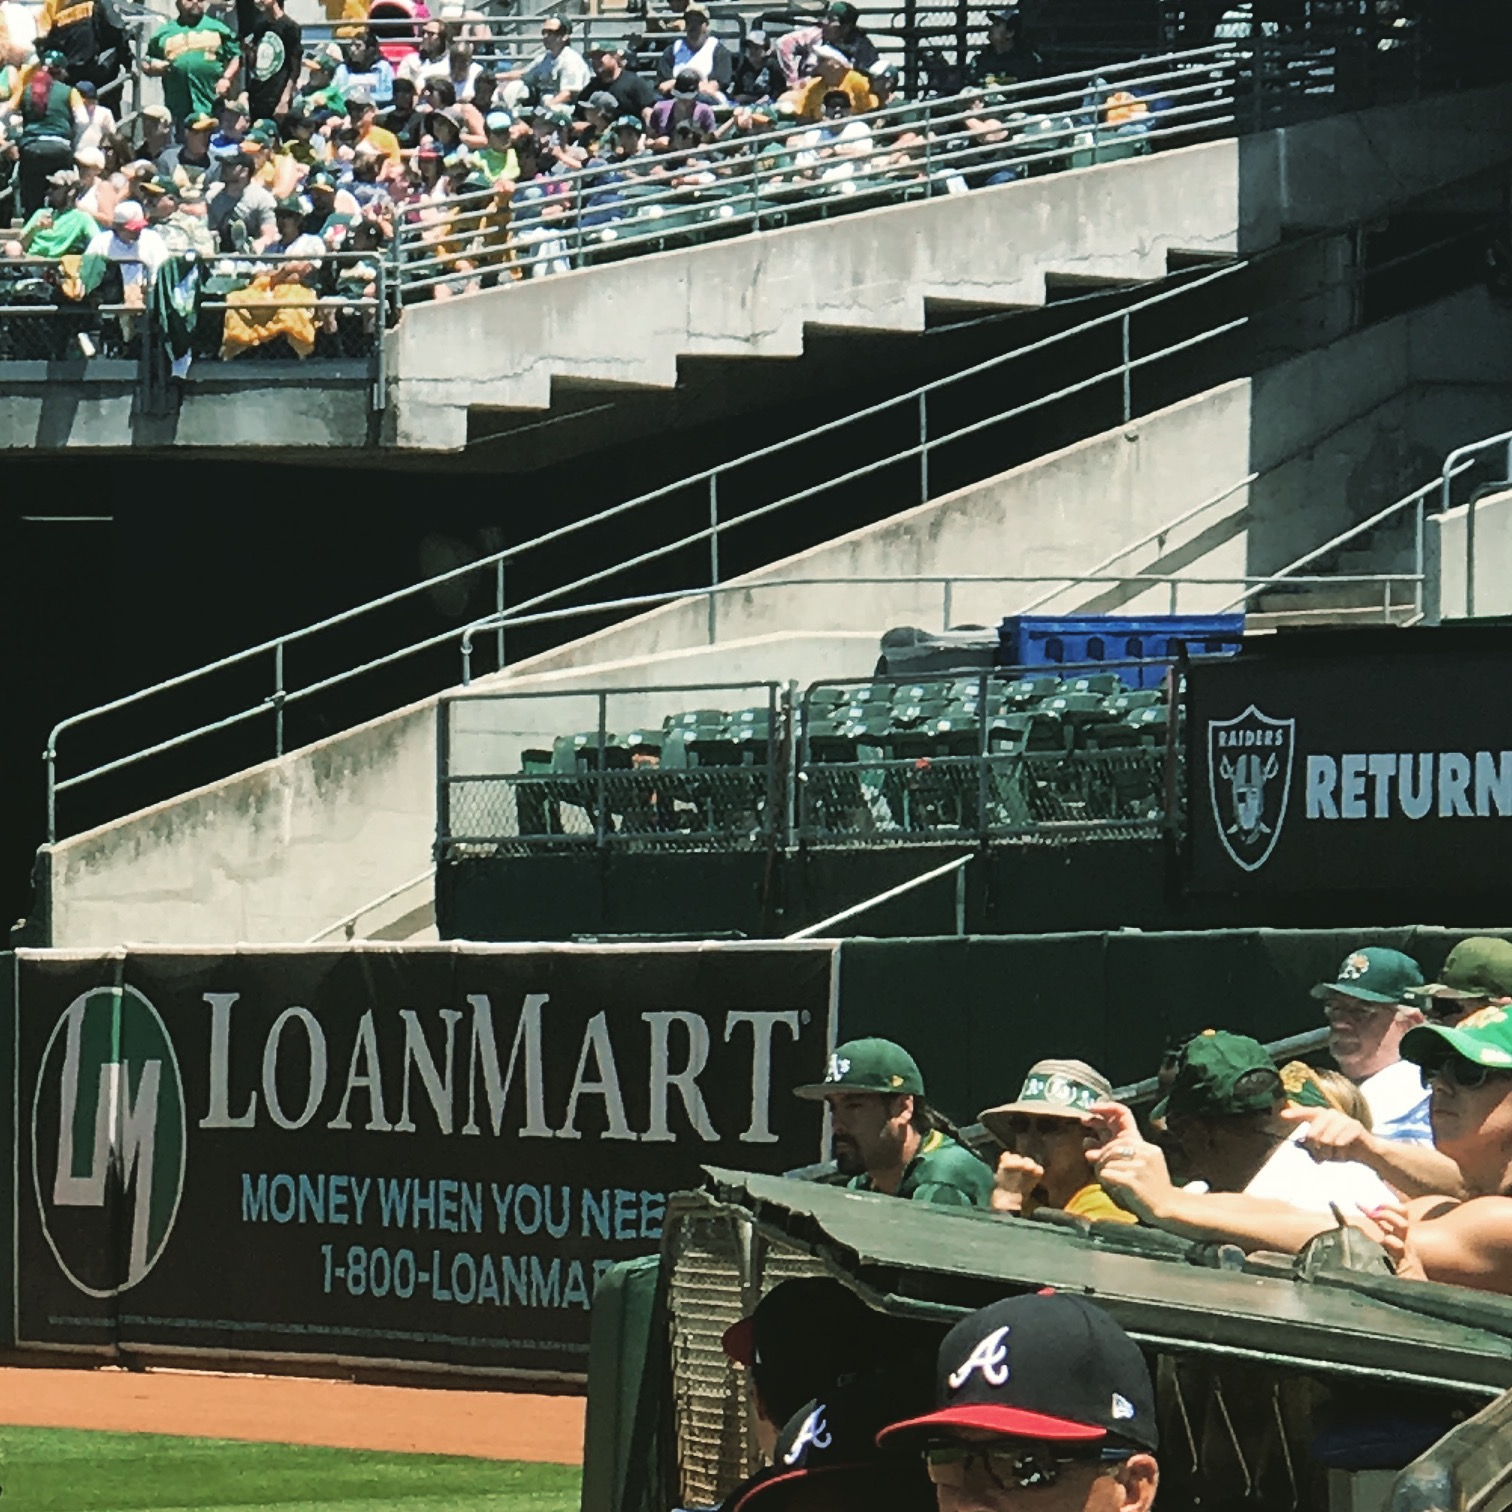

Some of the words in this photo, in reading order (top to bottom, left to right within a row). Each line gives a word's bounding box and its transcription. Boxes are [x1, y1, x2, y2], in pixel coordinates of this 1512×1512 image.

[1219, 728, 1283, 747] RAIDERS
[1306, 751, 1512, 820] RETURN
[199, 992, 800, 1145] LOANMART
[241, 1172, 372, 1226] MONEY
[378, 1178, 484, 1235] WHEN
[491, 1183, 570, 1239] YOU
[581, 1188, 666, 1240] NEE
[949, 1325, 1010, 1389] A
